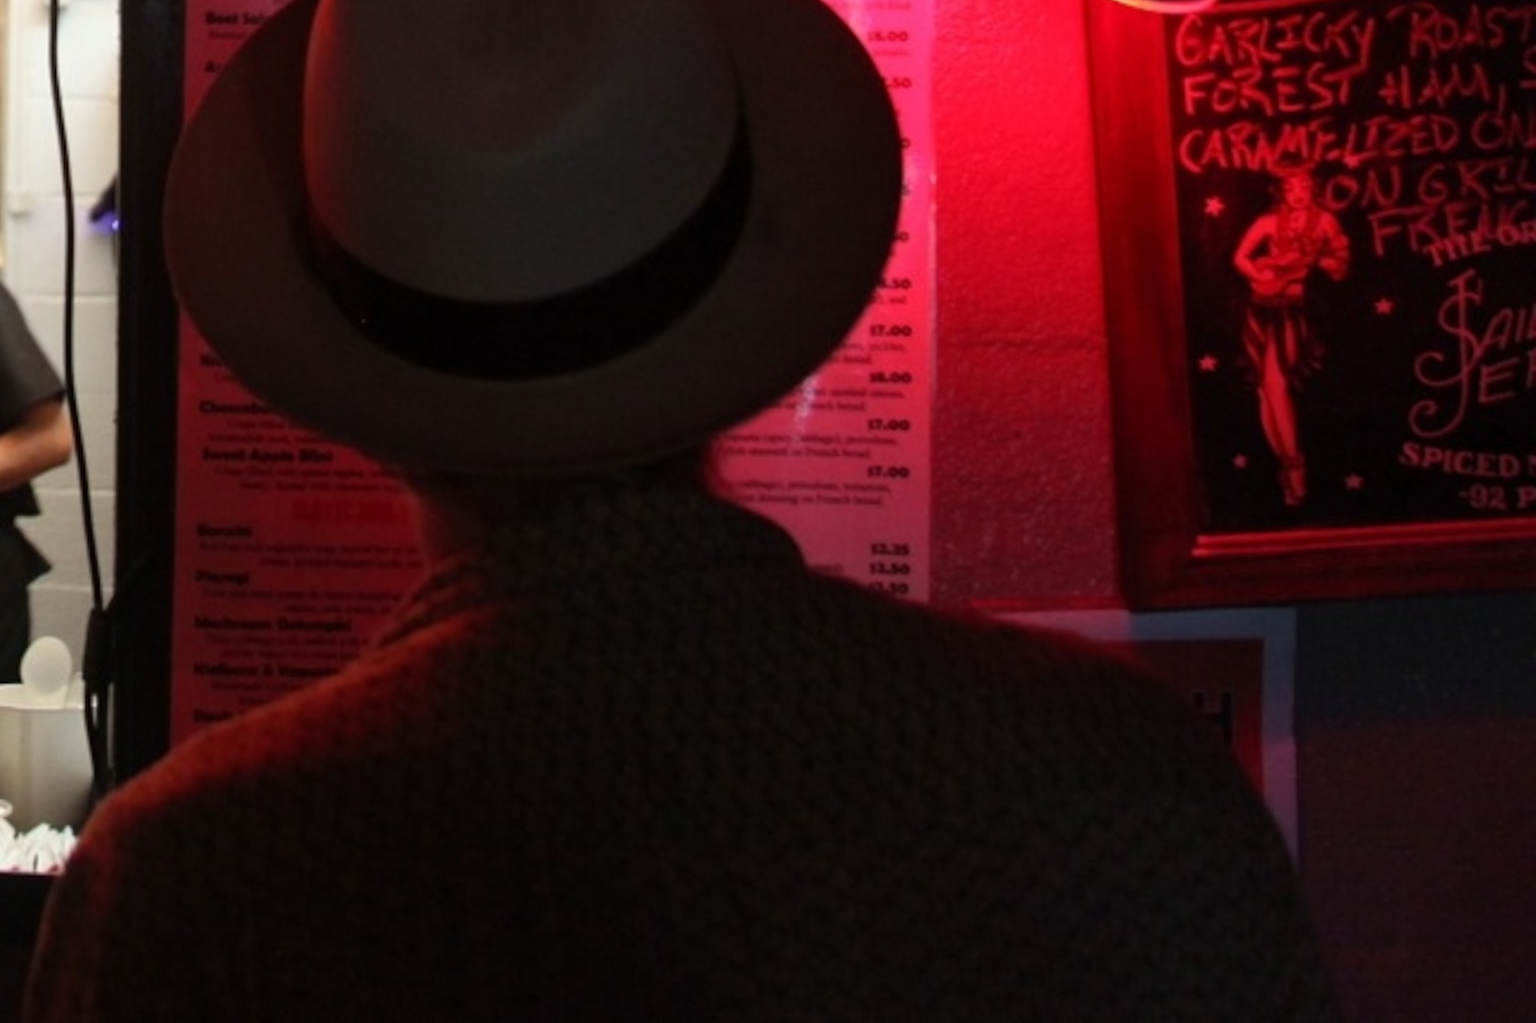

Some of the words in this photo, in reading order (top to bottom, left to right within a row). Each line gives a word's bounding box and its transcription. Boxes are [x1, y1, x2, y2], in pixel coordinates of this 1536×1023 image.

[1175, 10, 1375, 74] GARLICKY
[1183, 63, 1354, 116] FOREST
[1377, 64, 1508, 114] HAM,
[1178, 114, 1459, 173] CARAMELIZED
[1323, 163, 1402, 211] ON
[1398, 441, 1521, 479] SPICED
